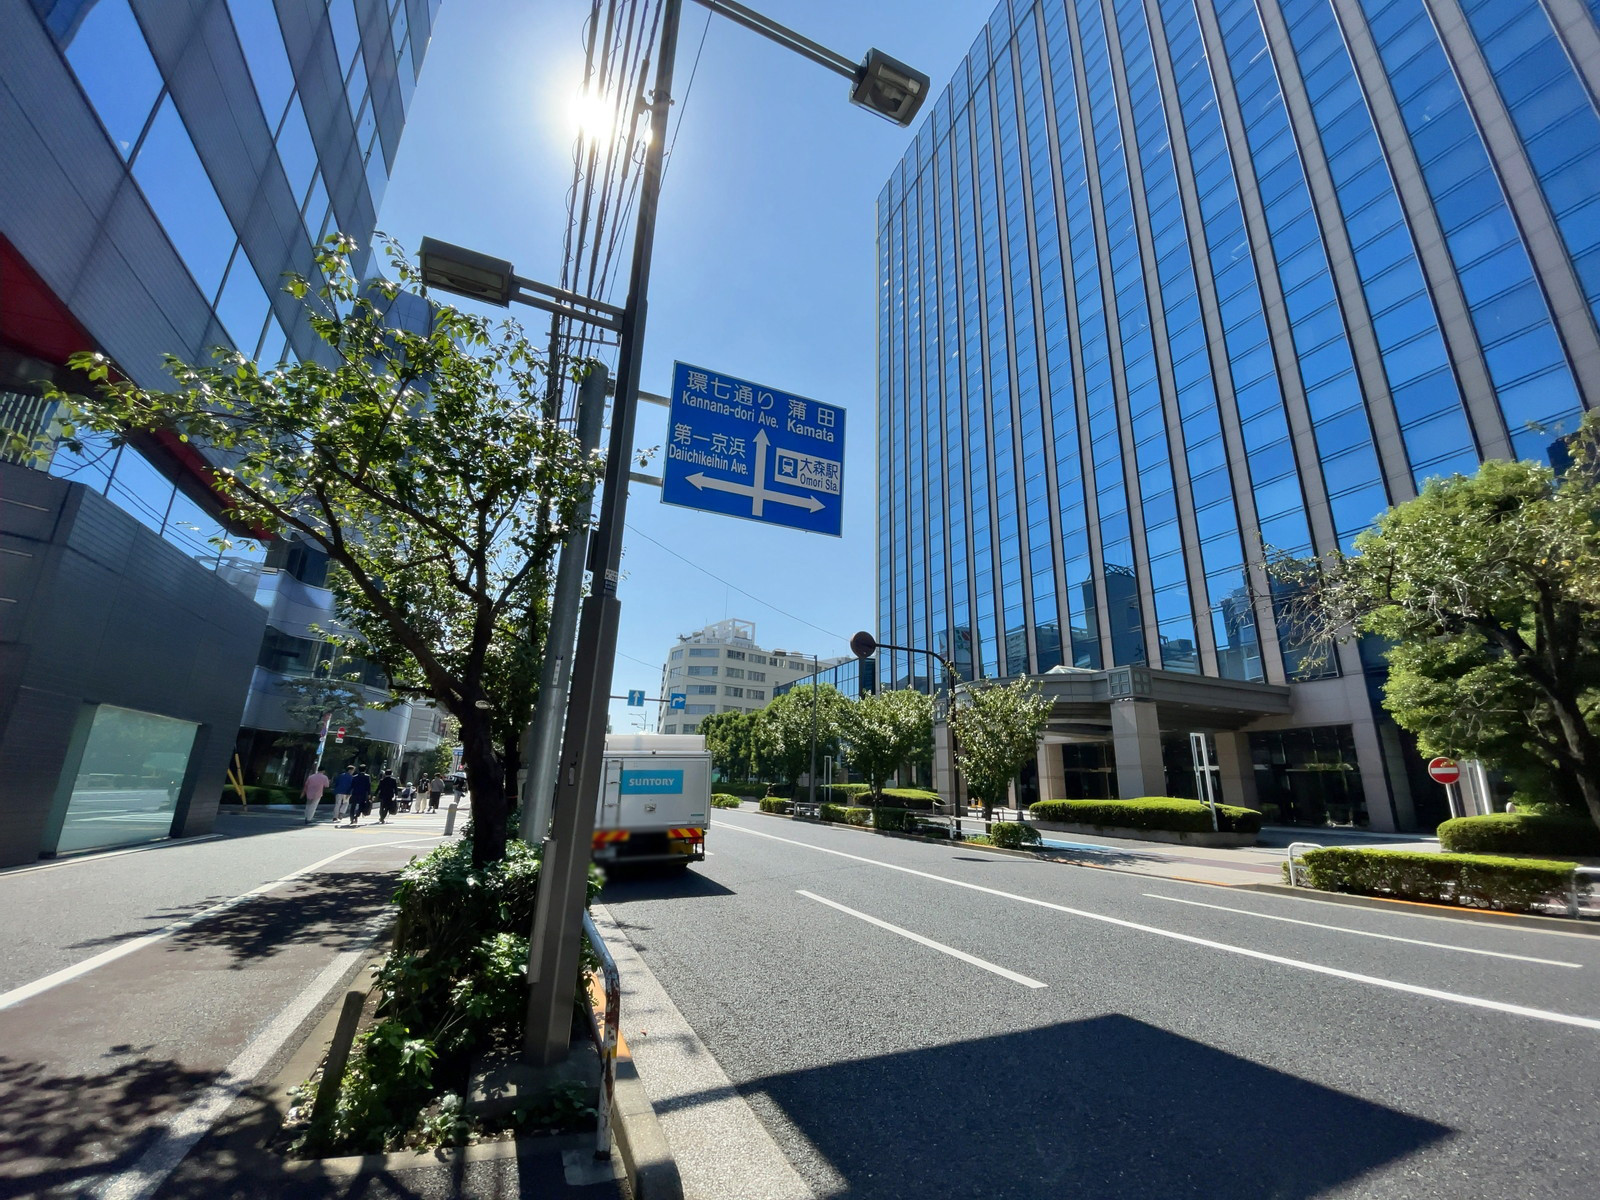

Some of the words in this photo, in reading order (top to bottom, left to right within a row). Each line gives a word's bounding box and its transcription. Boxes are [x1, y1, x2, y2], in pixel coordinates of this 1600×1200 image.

[687, 370, 774, 410] 環七通り
[682, 390, 755, 422] Kannana-dori
[757, 409, 779, 429] Ave.
[788, 399, 834, 427] 蒲田
[673, 422, 746, 459] 第一京浜
[787, 418, 834, 443] Kamata
[668, 443, 729, 471] Daiichikeihin
[730, 458, 749, 475] Ave.
[800, 458, 839, 480] 大森駅
[800, 473, 823, 489] Omori
[825, 478, 839, 493] Sta.
[628, 778, 675, 786] SUNTORY
